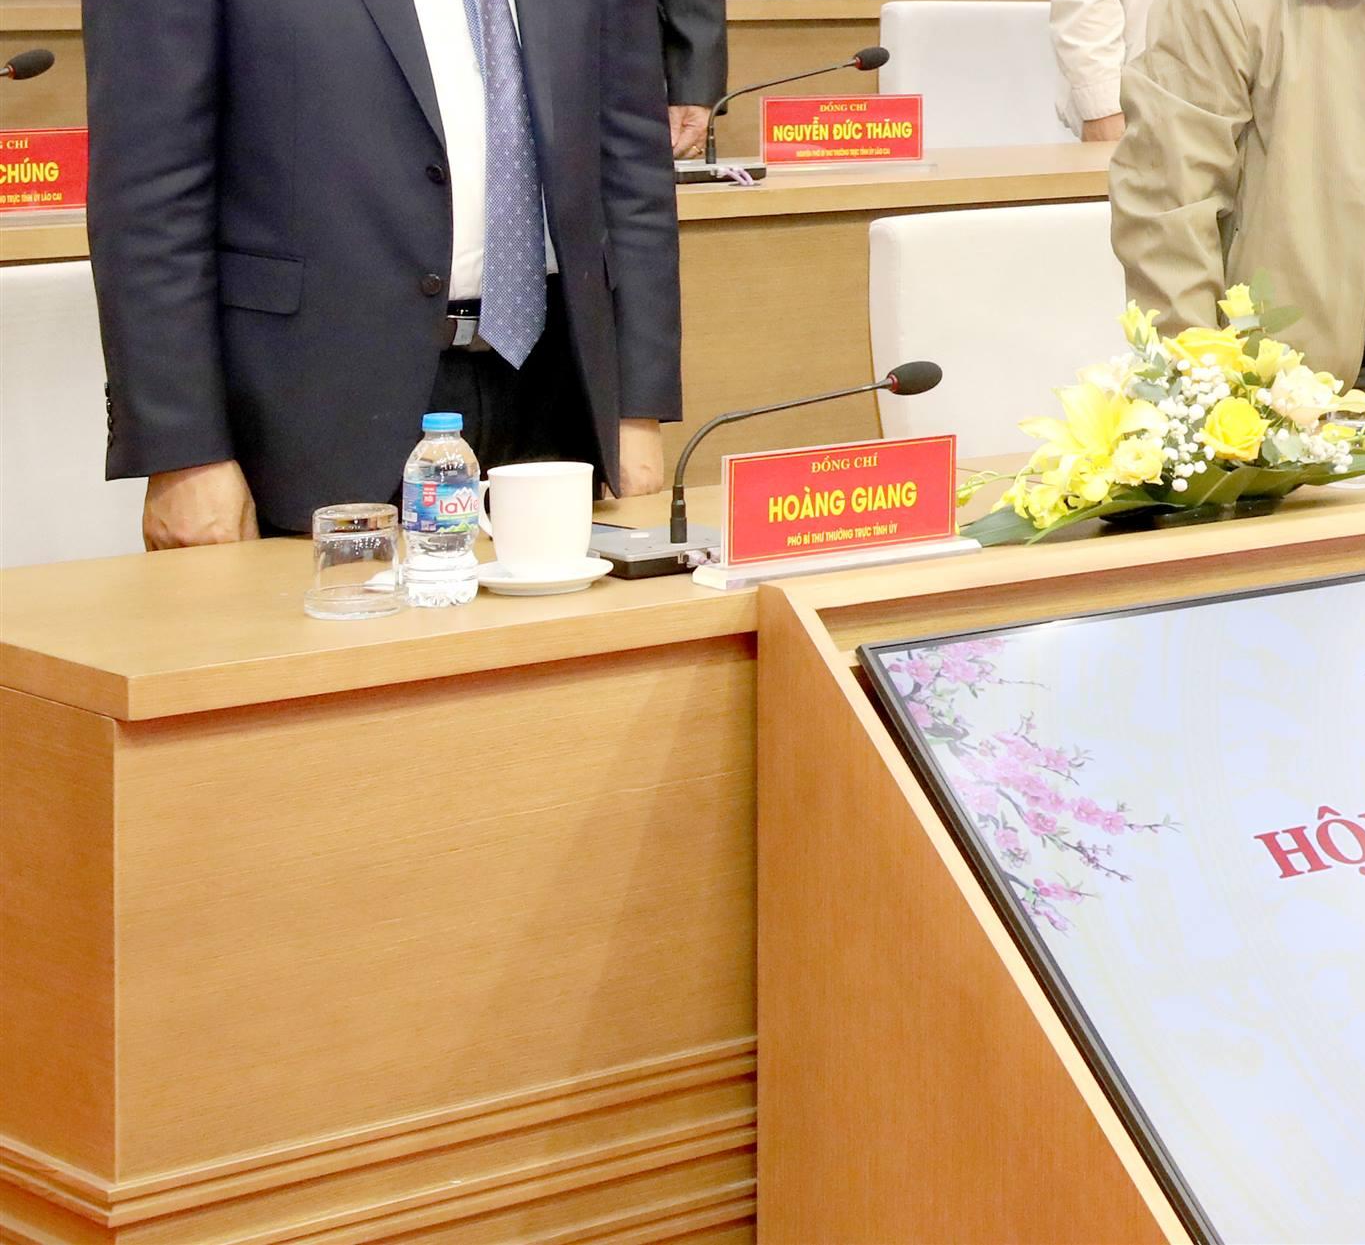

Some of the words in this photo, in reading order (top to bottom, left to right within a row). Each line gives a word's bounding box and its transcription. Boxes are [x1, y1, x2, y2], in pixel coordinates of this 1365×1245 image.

[820, 101, 848, 113] ĐỒNG
[850, 100, 867, 112] CHÍ
[773, 116, 828, 142] NGUYỄN
[833, 119, 863, 140] ĐỨC
[866, 119, 913, 140] THĂNG
[6, 137, 29, 150] CHÍ
[811, 452, 851, 474] ĐỒNG
[854, 451, 878, 469] CHÍ
[768, 485, 845, 524] HOÀNG
[851, 482, 918, 514] GIANG
[787, 532, 802, 547] PHÓ
[803, 531, 810, 545] BÍ
[811, 531, 825, 543] THƯ
[826, 527, 853, 541] THƯỜNG
[855, 526, 872, 540] TRỰC
